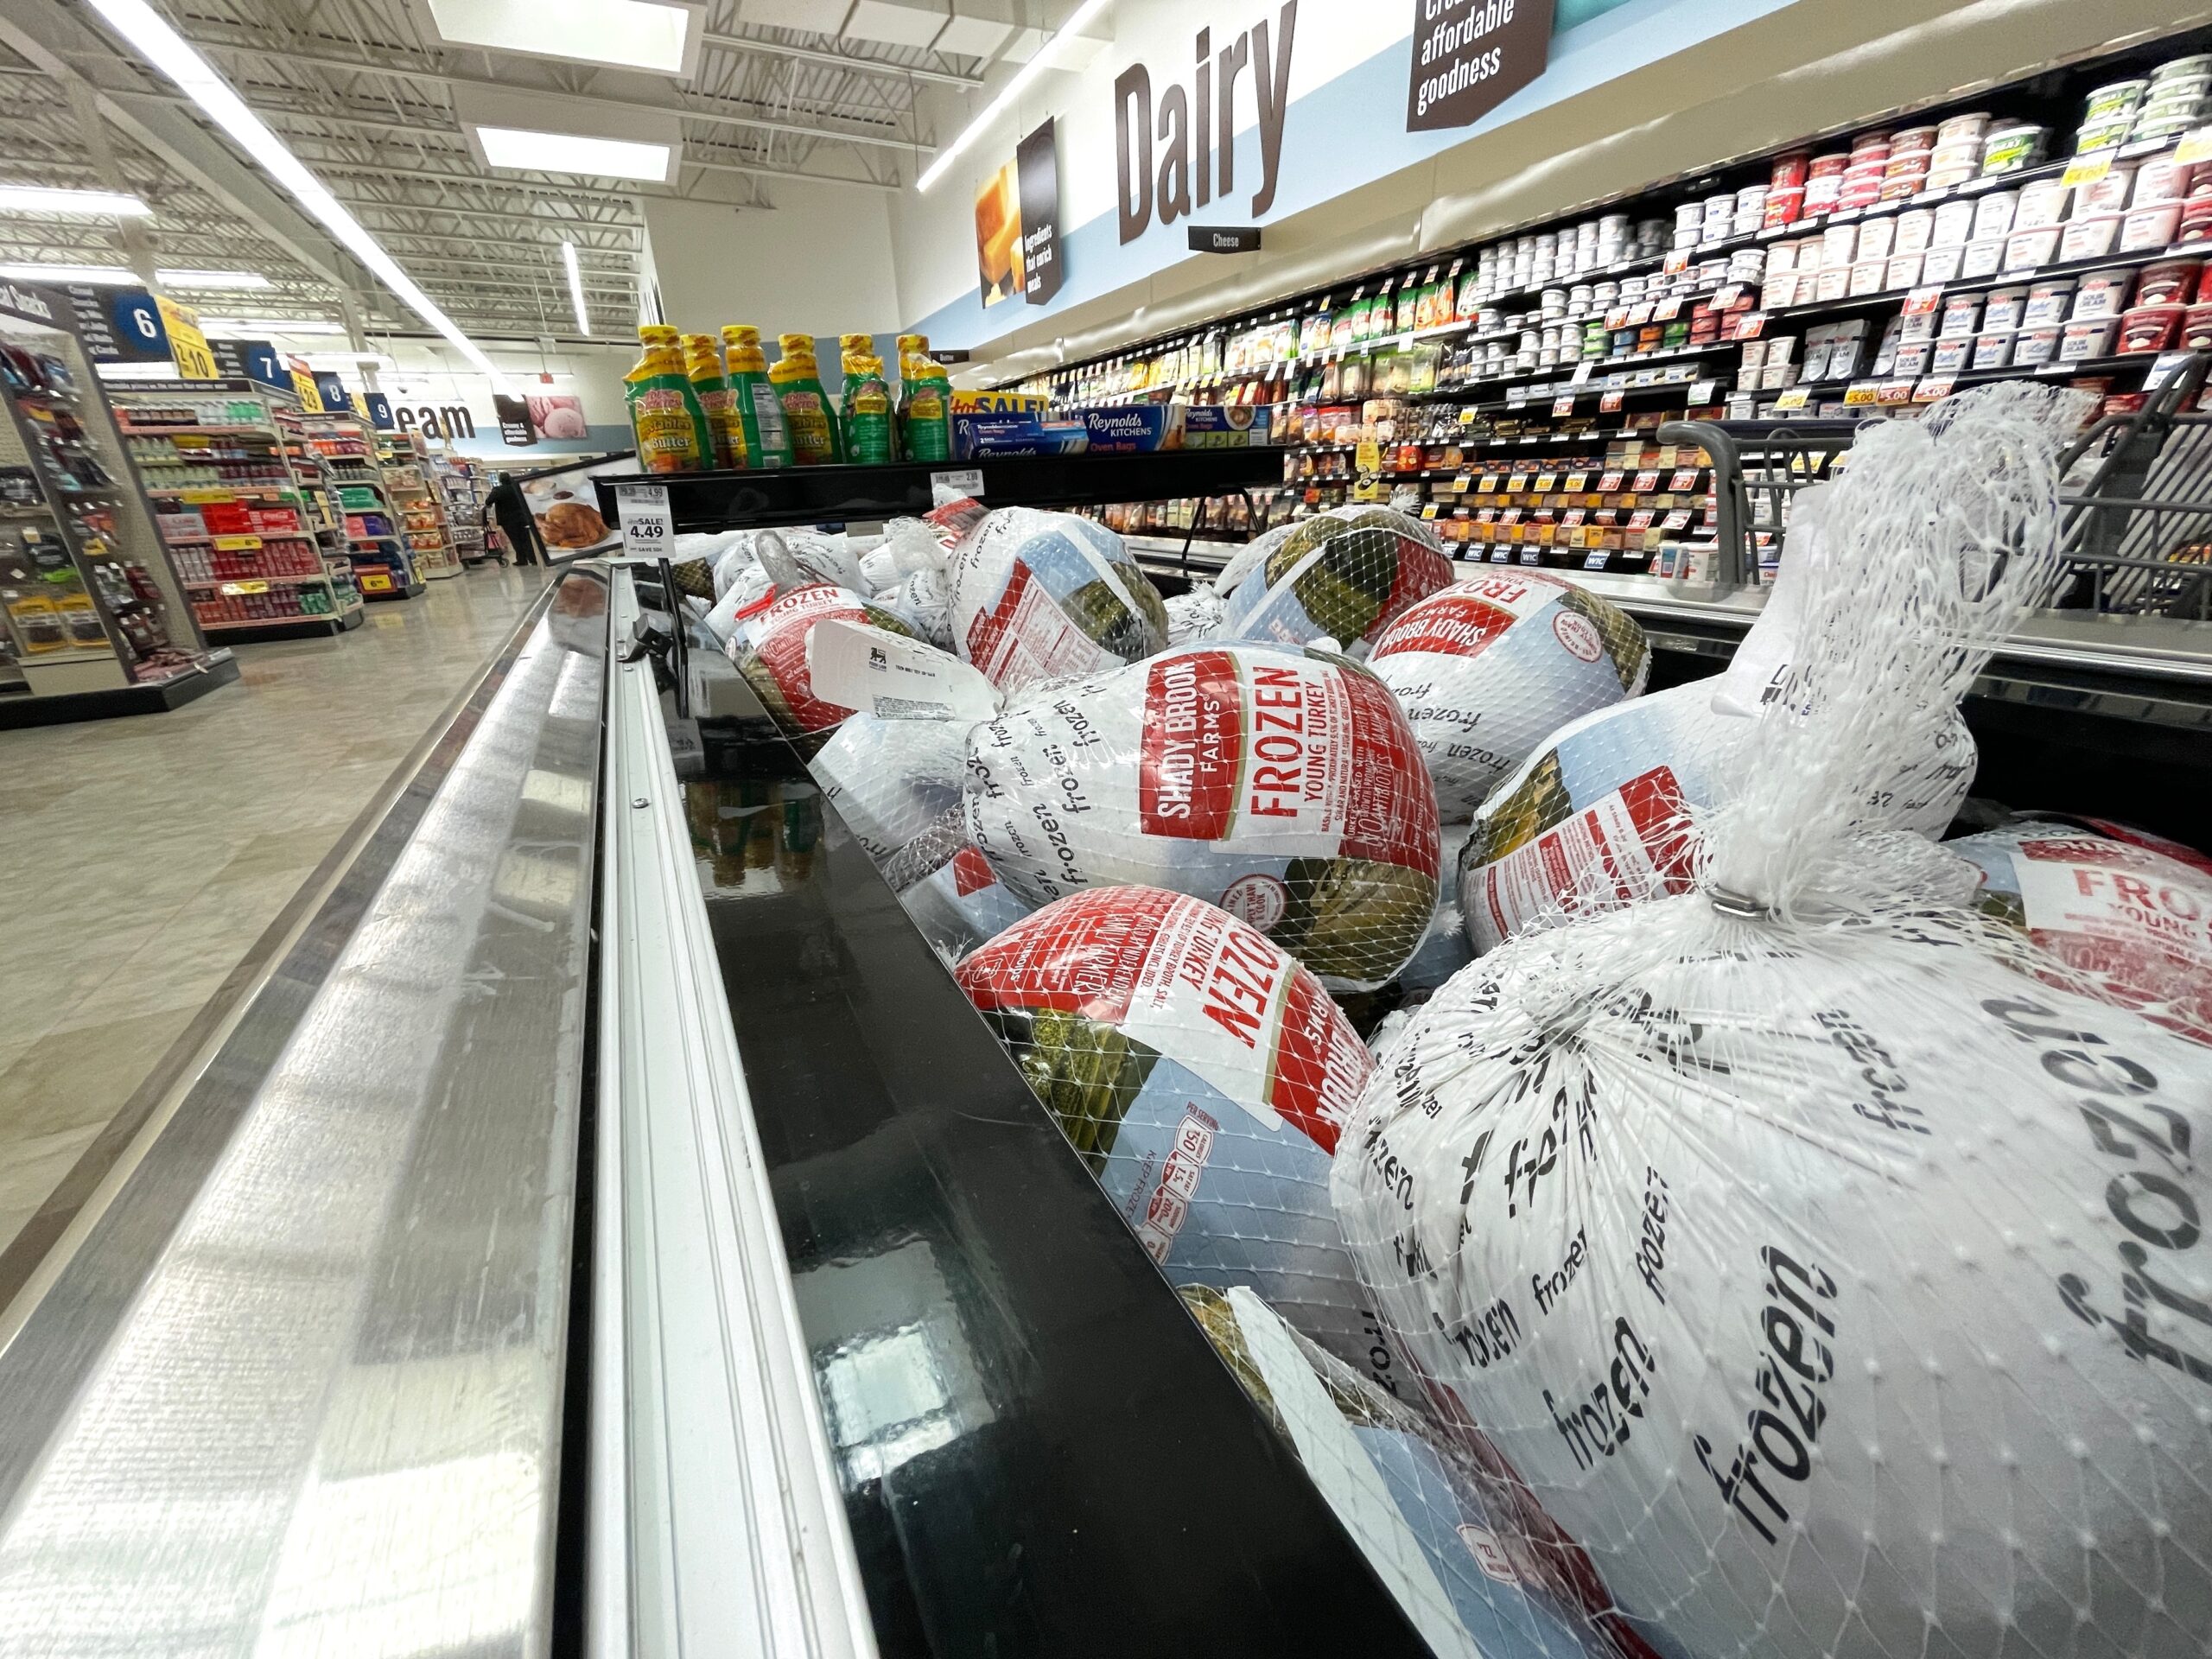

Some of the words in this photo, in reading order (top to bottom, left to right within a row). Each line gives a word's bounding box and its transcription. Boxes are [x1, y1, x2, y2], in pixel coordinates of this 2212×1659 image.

[1421, 0, 1514, 66] affordable
[1417, 47, 1502, 117] goodness
[1114, 0, 1296, 246] Dairy
[1213, 233, 1239, 247] Cheese
[133, 308, 156, 338] 6
[260, 357, 272, 378] 7
[329, 385, 341, 403] 8
[977, 397, 1044, 414] SALE!
[1853, 393, 1873, 404] 5.00
[1885, 391, 1908, 401] 5.00
[378, 404, 388, 419] 9
[1088, 413, 1142, 433] Reynolds
[1185, 408, 1213, 419] Reynolds
[652, 435, 690, 448] Butter
[1110, 427, 1153, 437] KITCHENS
[978, 448, 1037, 459] Reynolds
[1090, 442, 1113, 452] Oven
[1116, 442, 1136, 452] Bags
[631, 525, 664, 538] 4.49
[971, 521, 995, 569] frozen
[1467, 550, 1481, 558] WIC
[1493, 551, 1508, 560] WIC
[1522, 552, 1537, 563] WIC
[1587, 556, 1605, 566] WIC
[951, 551, 969, 608] frozen
[760, 588, 839, 623] FROZEN
[1417, 605, 1468, 621] FARMS
[1382, 623, 1430, 649] BROOK
[1427, 619, 1487, 647] SHADY
[1165, 662, 1197, 733] BROOK
[1393, 682, 1433, 699] fro
[1053, 700, 1101, 747] frozen
[1308, 681, 1327, 742] TURKEY
[1407, 706, 1482, 734] frozen
[988, 721, 1013, 748] froz
[1200, 700, 1221, 773] FARMS
[1250, 666, 1304, 817] FROZEN
[1417, 739, 1439, 758] froz
[1010, 756, 1035, 786] frozen
[1447, 741, 1511, 775] frozen
[1042, 745, 1092, 813] frozen
[1157, 740, 1197, 819] SHADY
[1305, 744, 1326, 803] YOUNG
[1004, 820, 1033, 857] frozen
[1033, 804, 1089, 885] frozen
[1255, 893, 1266, 913] COOK
[2073, 868, 2201, 922] FRO
[2107, 902, 2198, 940] YOUNG
[1010, 941, 1037, 982] STEROIDS
[1179, 930, 1219, 991] TURKEY
[1149, 988, 1168, 1010] SALT,
[1202, 925, 1281, 1050] OZEN
[1305, 993, 1329, 1046] RMS
[1186, 1101, 1197, 1116] PER
[1197, 1109, 1221, 1131] SERVING
[1183, 1130, 1201, 1152] 150
[1194, 1134, 1209, 1160] CALORIES
[1142, 1149, 1158, 1181] KEEP
[1187, 1171, 1196, 1182] SAT
[1980, 995, 2212, 1389] frozen
[1542, 1316, 1656, 1471] frozen
[1694, 1244, 1840, 1547] frozen
